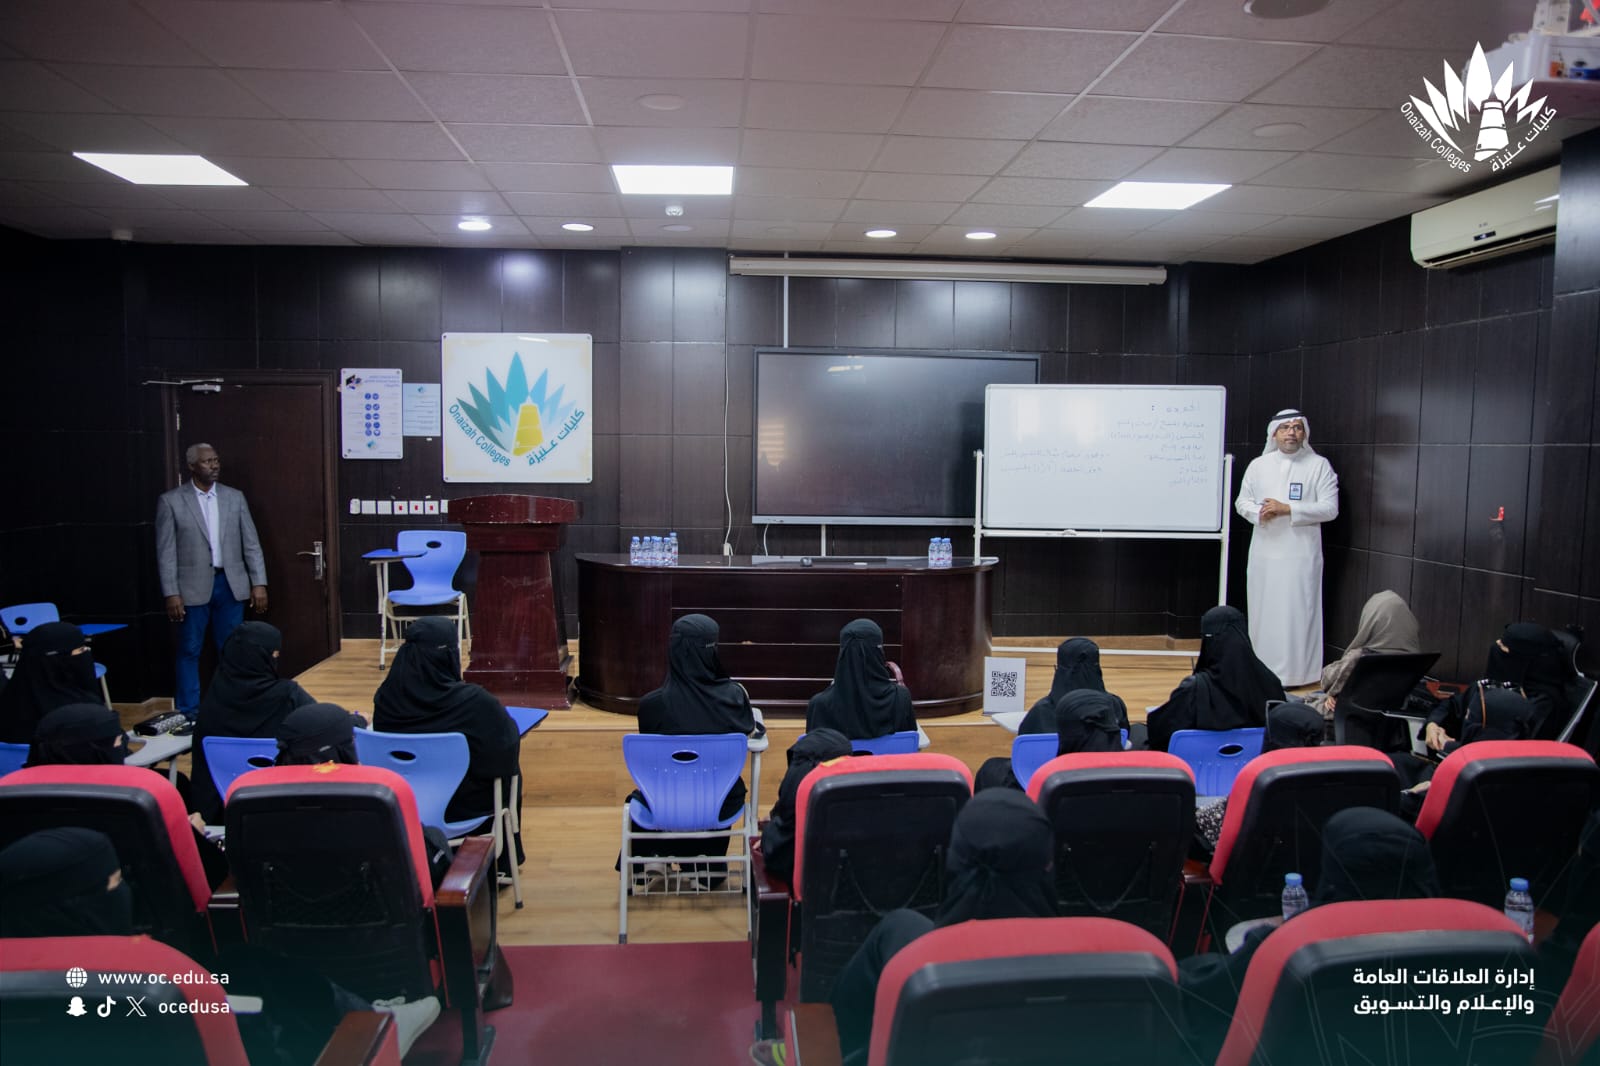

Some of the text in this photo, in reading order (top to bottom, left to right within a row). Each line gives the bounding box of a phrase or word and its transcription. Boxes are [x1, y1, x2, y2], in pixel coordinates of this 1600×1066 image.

[449, 403, 477, 439] Onaizah
[475, 434, 511, 466] Colleges
[557, 407, 585, 441] كليات
